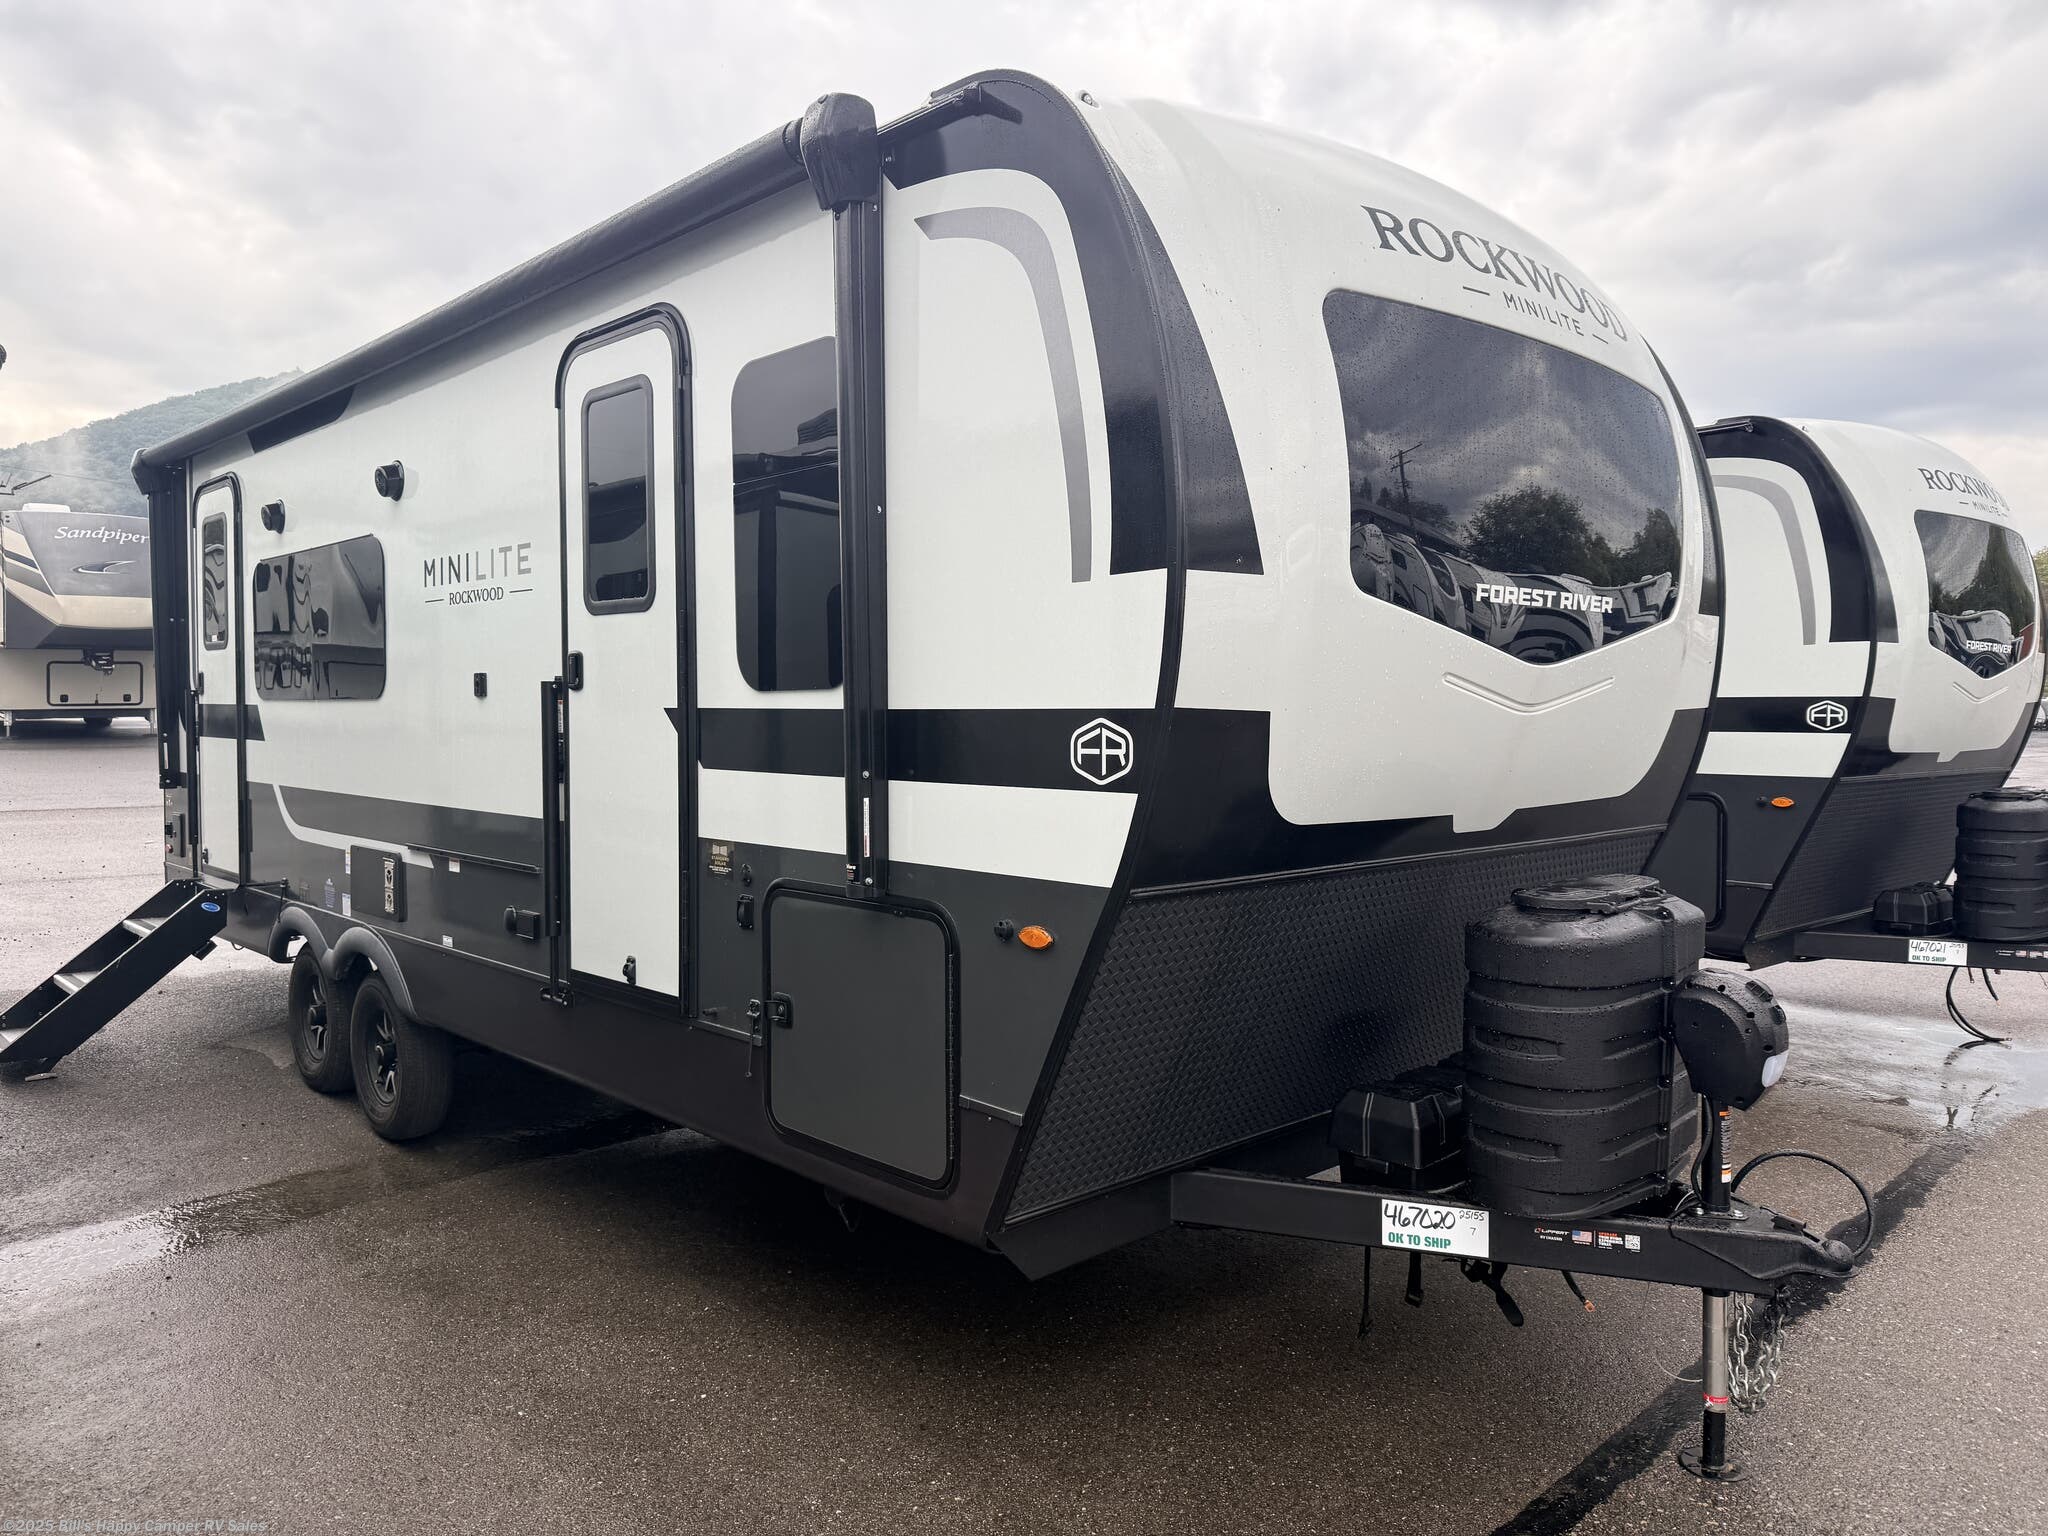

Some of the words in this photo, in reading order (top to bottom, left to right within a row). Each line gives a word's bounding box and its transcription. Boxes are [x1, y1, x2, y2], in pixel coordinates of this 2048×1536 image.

[1361, 205, 1627, 342] ROCKWOOD
[1502, 290, 1584, 337] MINILITE
[54, 526, 150, 544] Sandpiper
[424, 542, 532, 588] MINILITE
[449, 586, 504, 605] ROCKWOOD
[1475, 583, 1557, 608] FOREST
[1559, 591, 1613, 614] RIVER
[1966, 640, 1993, 651] FOREST
[1992, 643, 2013, 654] RIVER
[1911, 941, 1946, 953] 467021
[1384, 1203, 1456, 1229] 467020
[1388, 1231, 1404, 1244] OK
[1407, 1234, 1421, 1246] TO
[1424, 1236, 1451, 1249] SHIP
